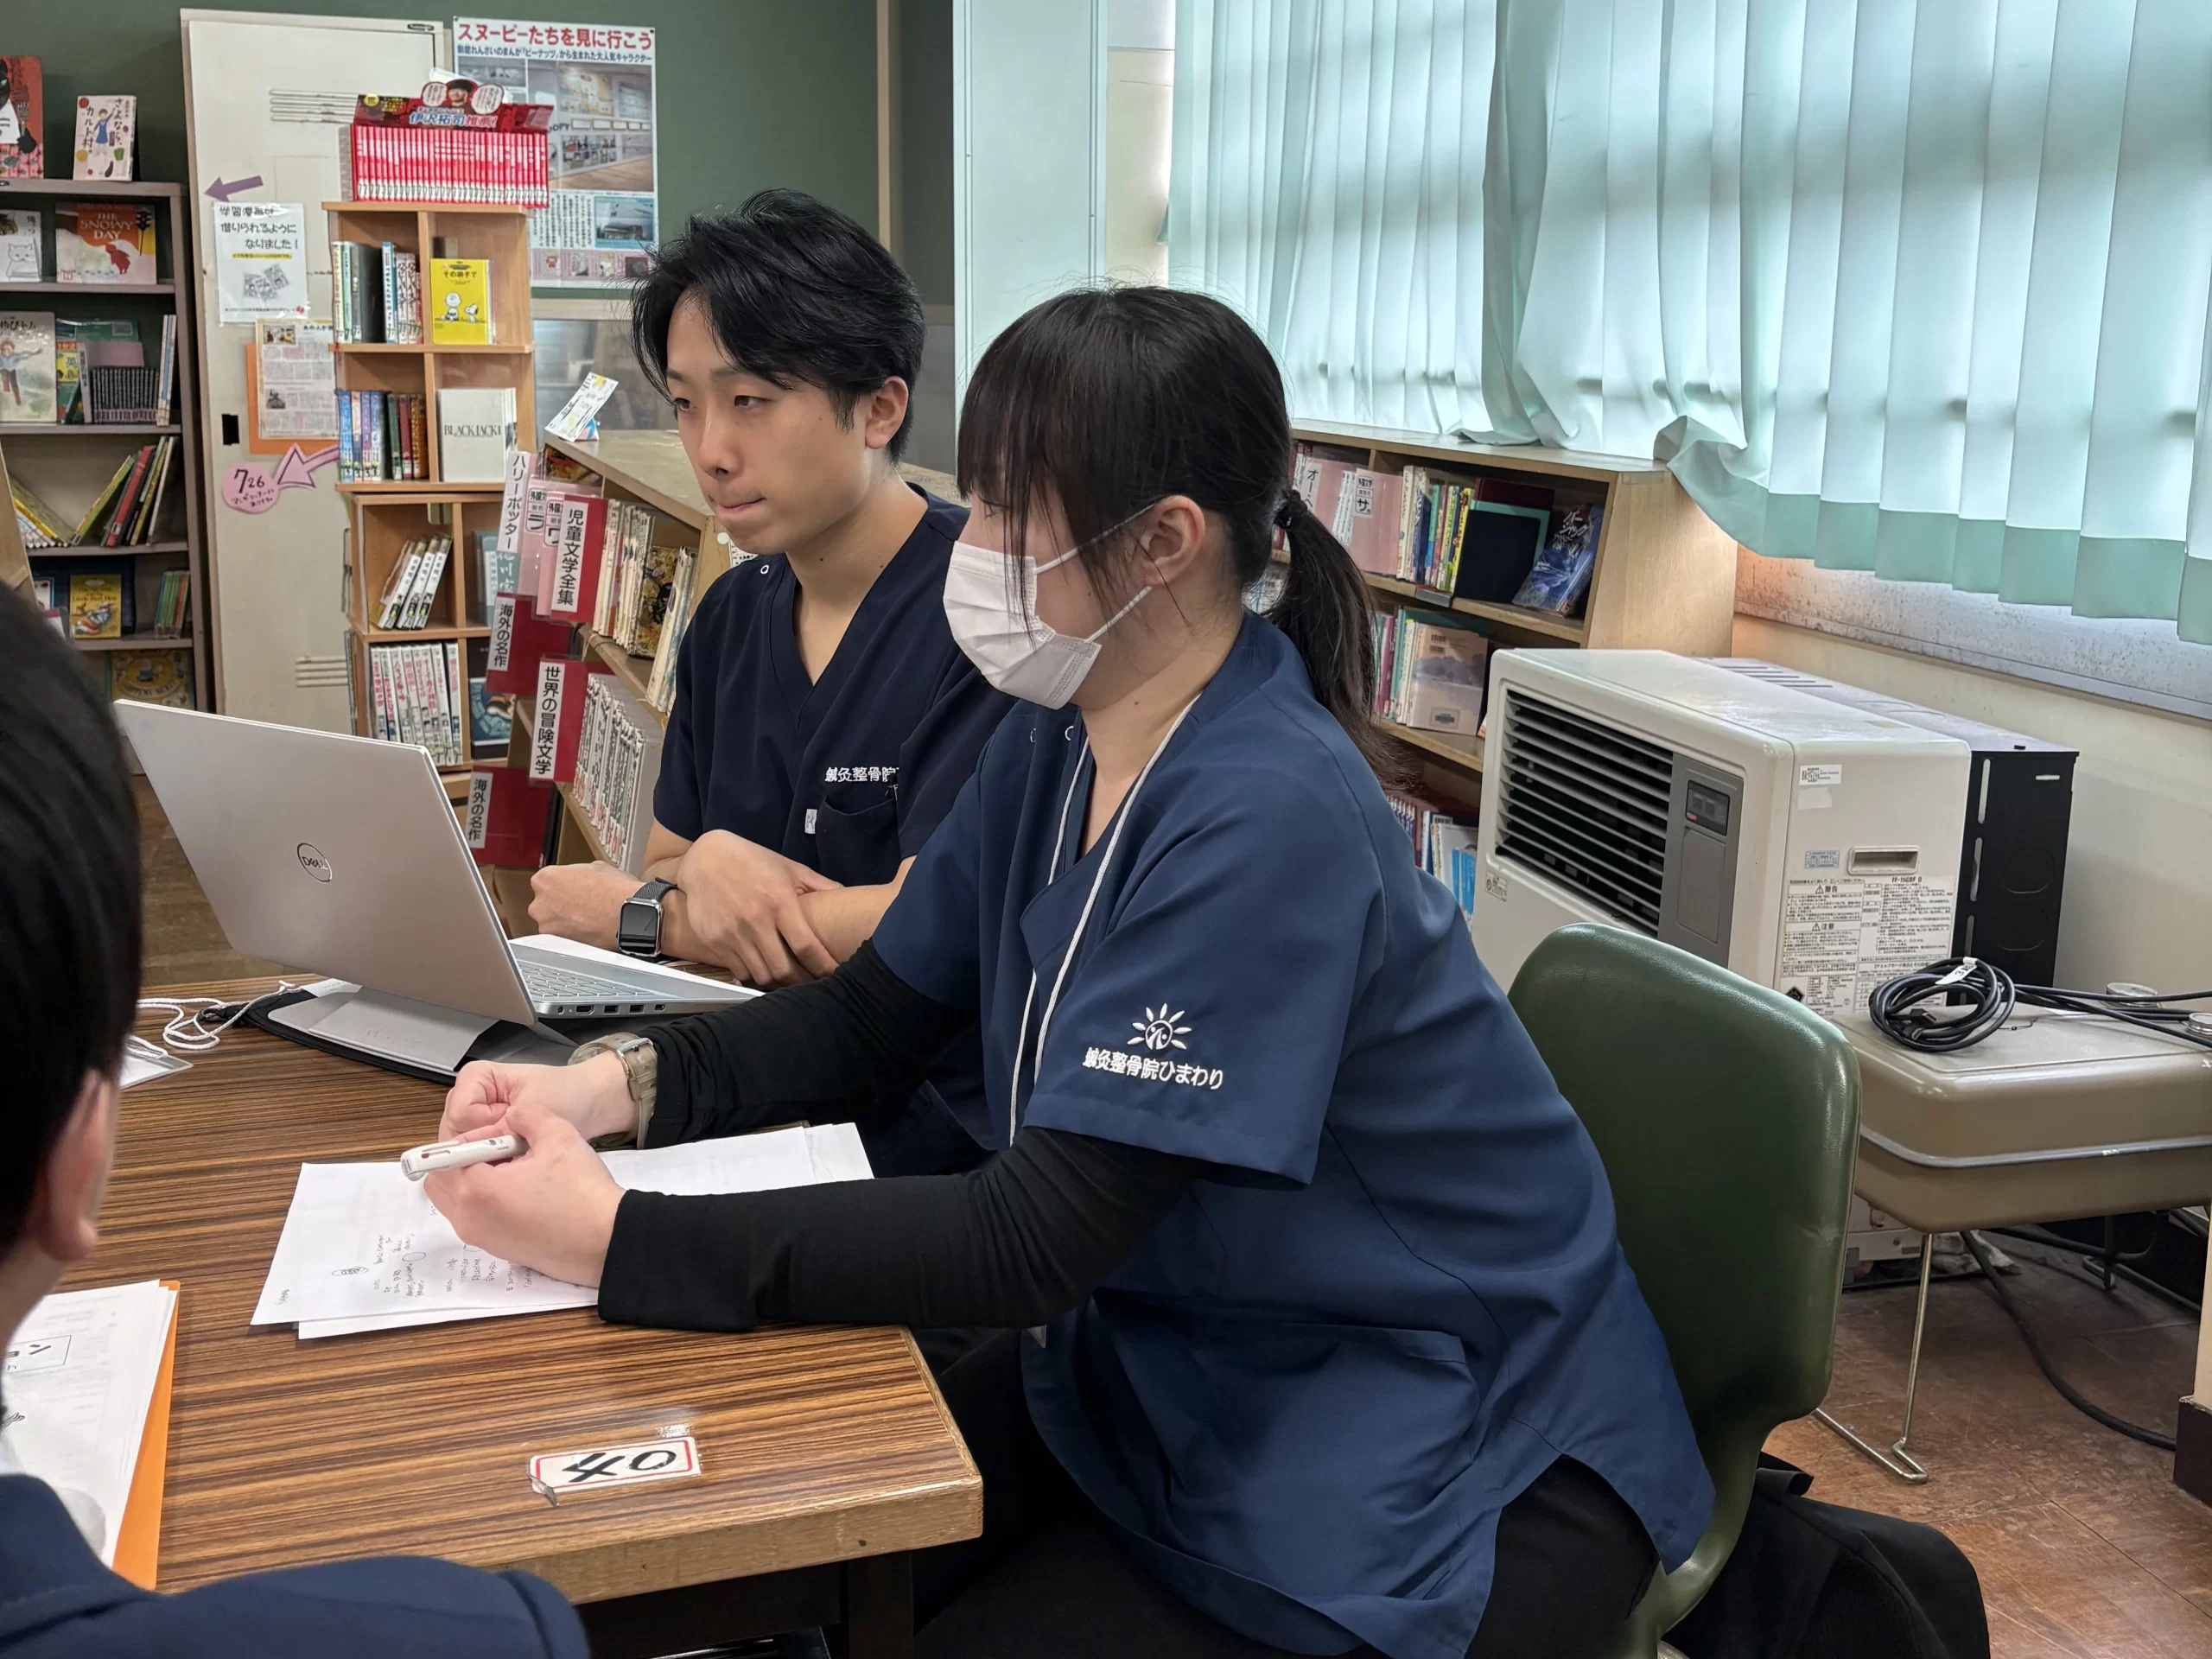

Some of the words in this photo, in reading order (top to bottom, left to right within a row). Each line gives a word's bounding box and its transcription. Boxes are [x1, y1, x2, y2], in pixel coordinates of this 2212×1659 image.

[458, 23, 652, 50] スヌーピーたちを見に行こう
[80, 219, 132, 231] SNOWY
[93, 231, 121, 240] DAY
[221, 222, 297, 233] 借りられるように
[444, 424, 474, 436] BLACK
[234, 468, 265, 493] 726
[1305, 469, 1319, 508] オー・ヘ
[501, 455, 526, 550] ハリーポッター
[530, 490, 547, 501] 外国文
[558, 509, 584, 606] 児童文学全集
[493, 603, 514, 667] 海外の名作
[535, 666, 562, 775] 世界の冒険文学
[824, 766, 899, 783] 鍼灸整骨院
[468, 779, 488, 841] 海外の名作
[302, 855, 328, 871] DELL
[1082, 1046, 1224, 1090] 鍼灸整骨院ひまわり
[562, 1452, 677, 1483] 40
